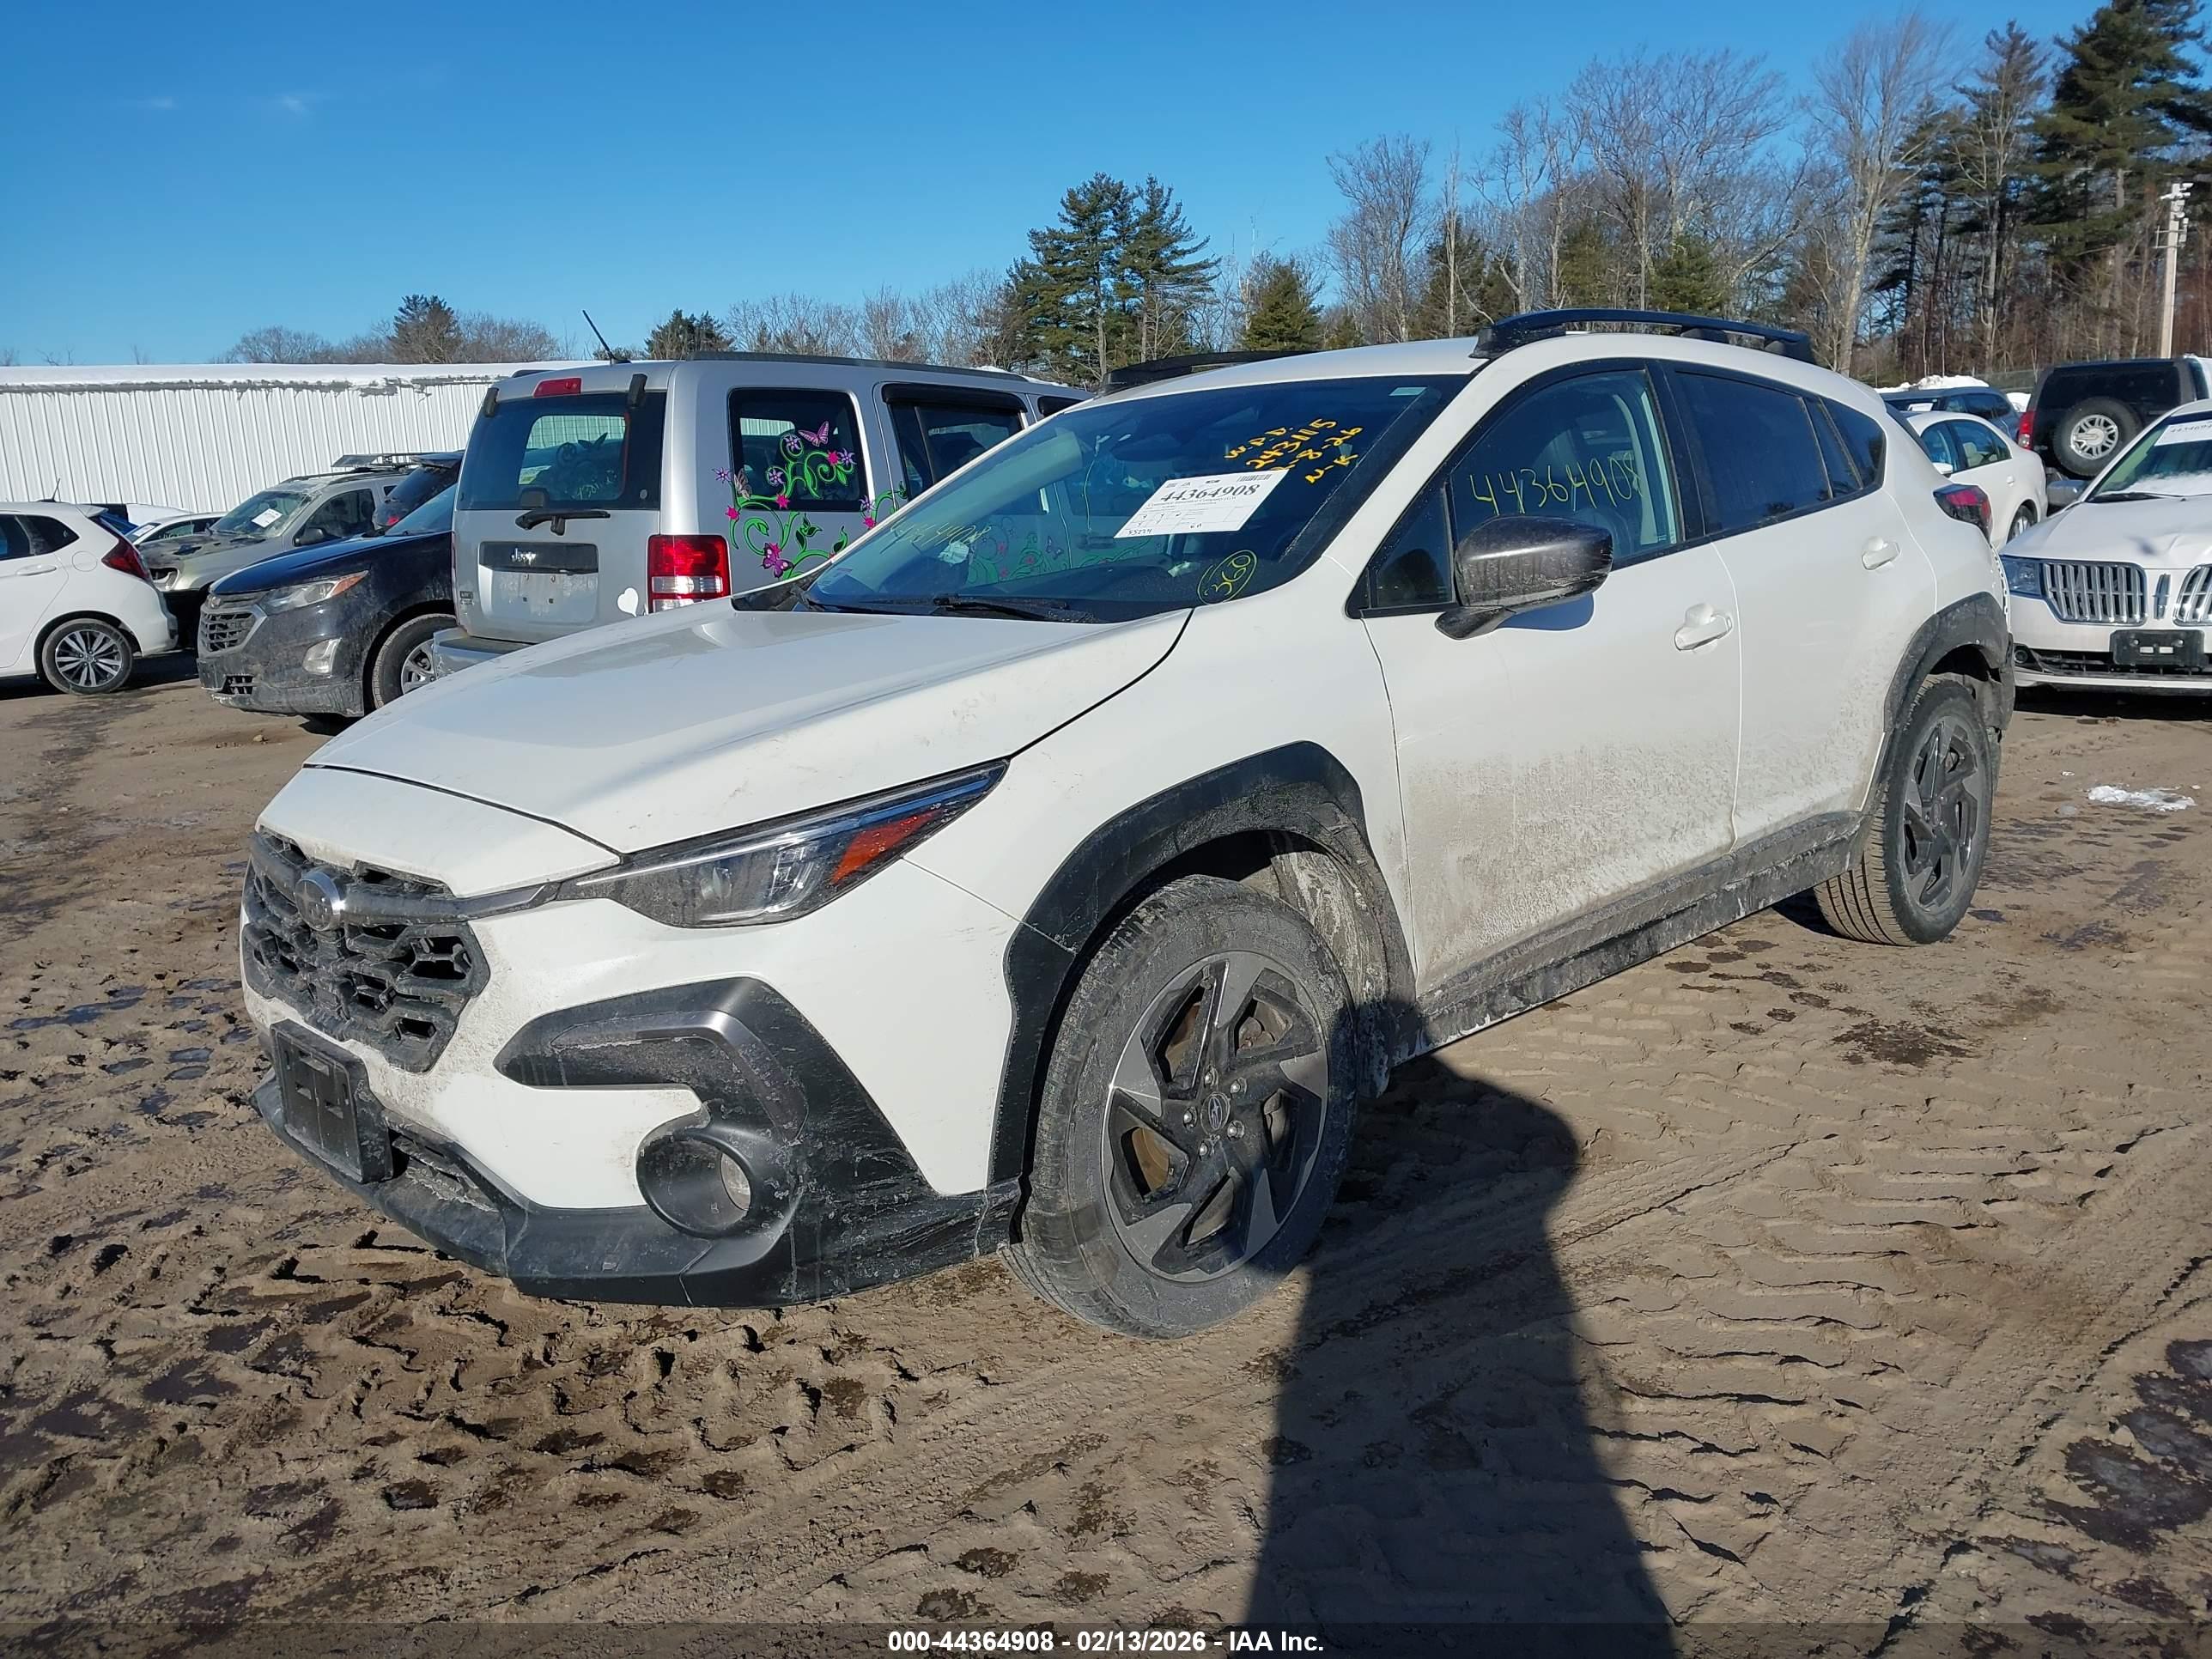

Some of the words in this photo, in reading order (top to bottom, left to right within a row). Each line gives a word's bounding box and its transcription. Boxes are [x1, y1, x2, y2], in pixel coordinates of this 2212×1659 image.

[1246, 418, 1337, 469] 243115
[1160, 483, 1261, 501] 44364908
[1469, 450, 1644, 516] 44364908
